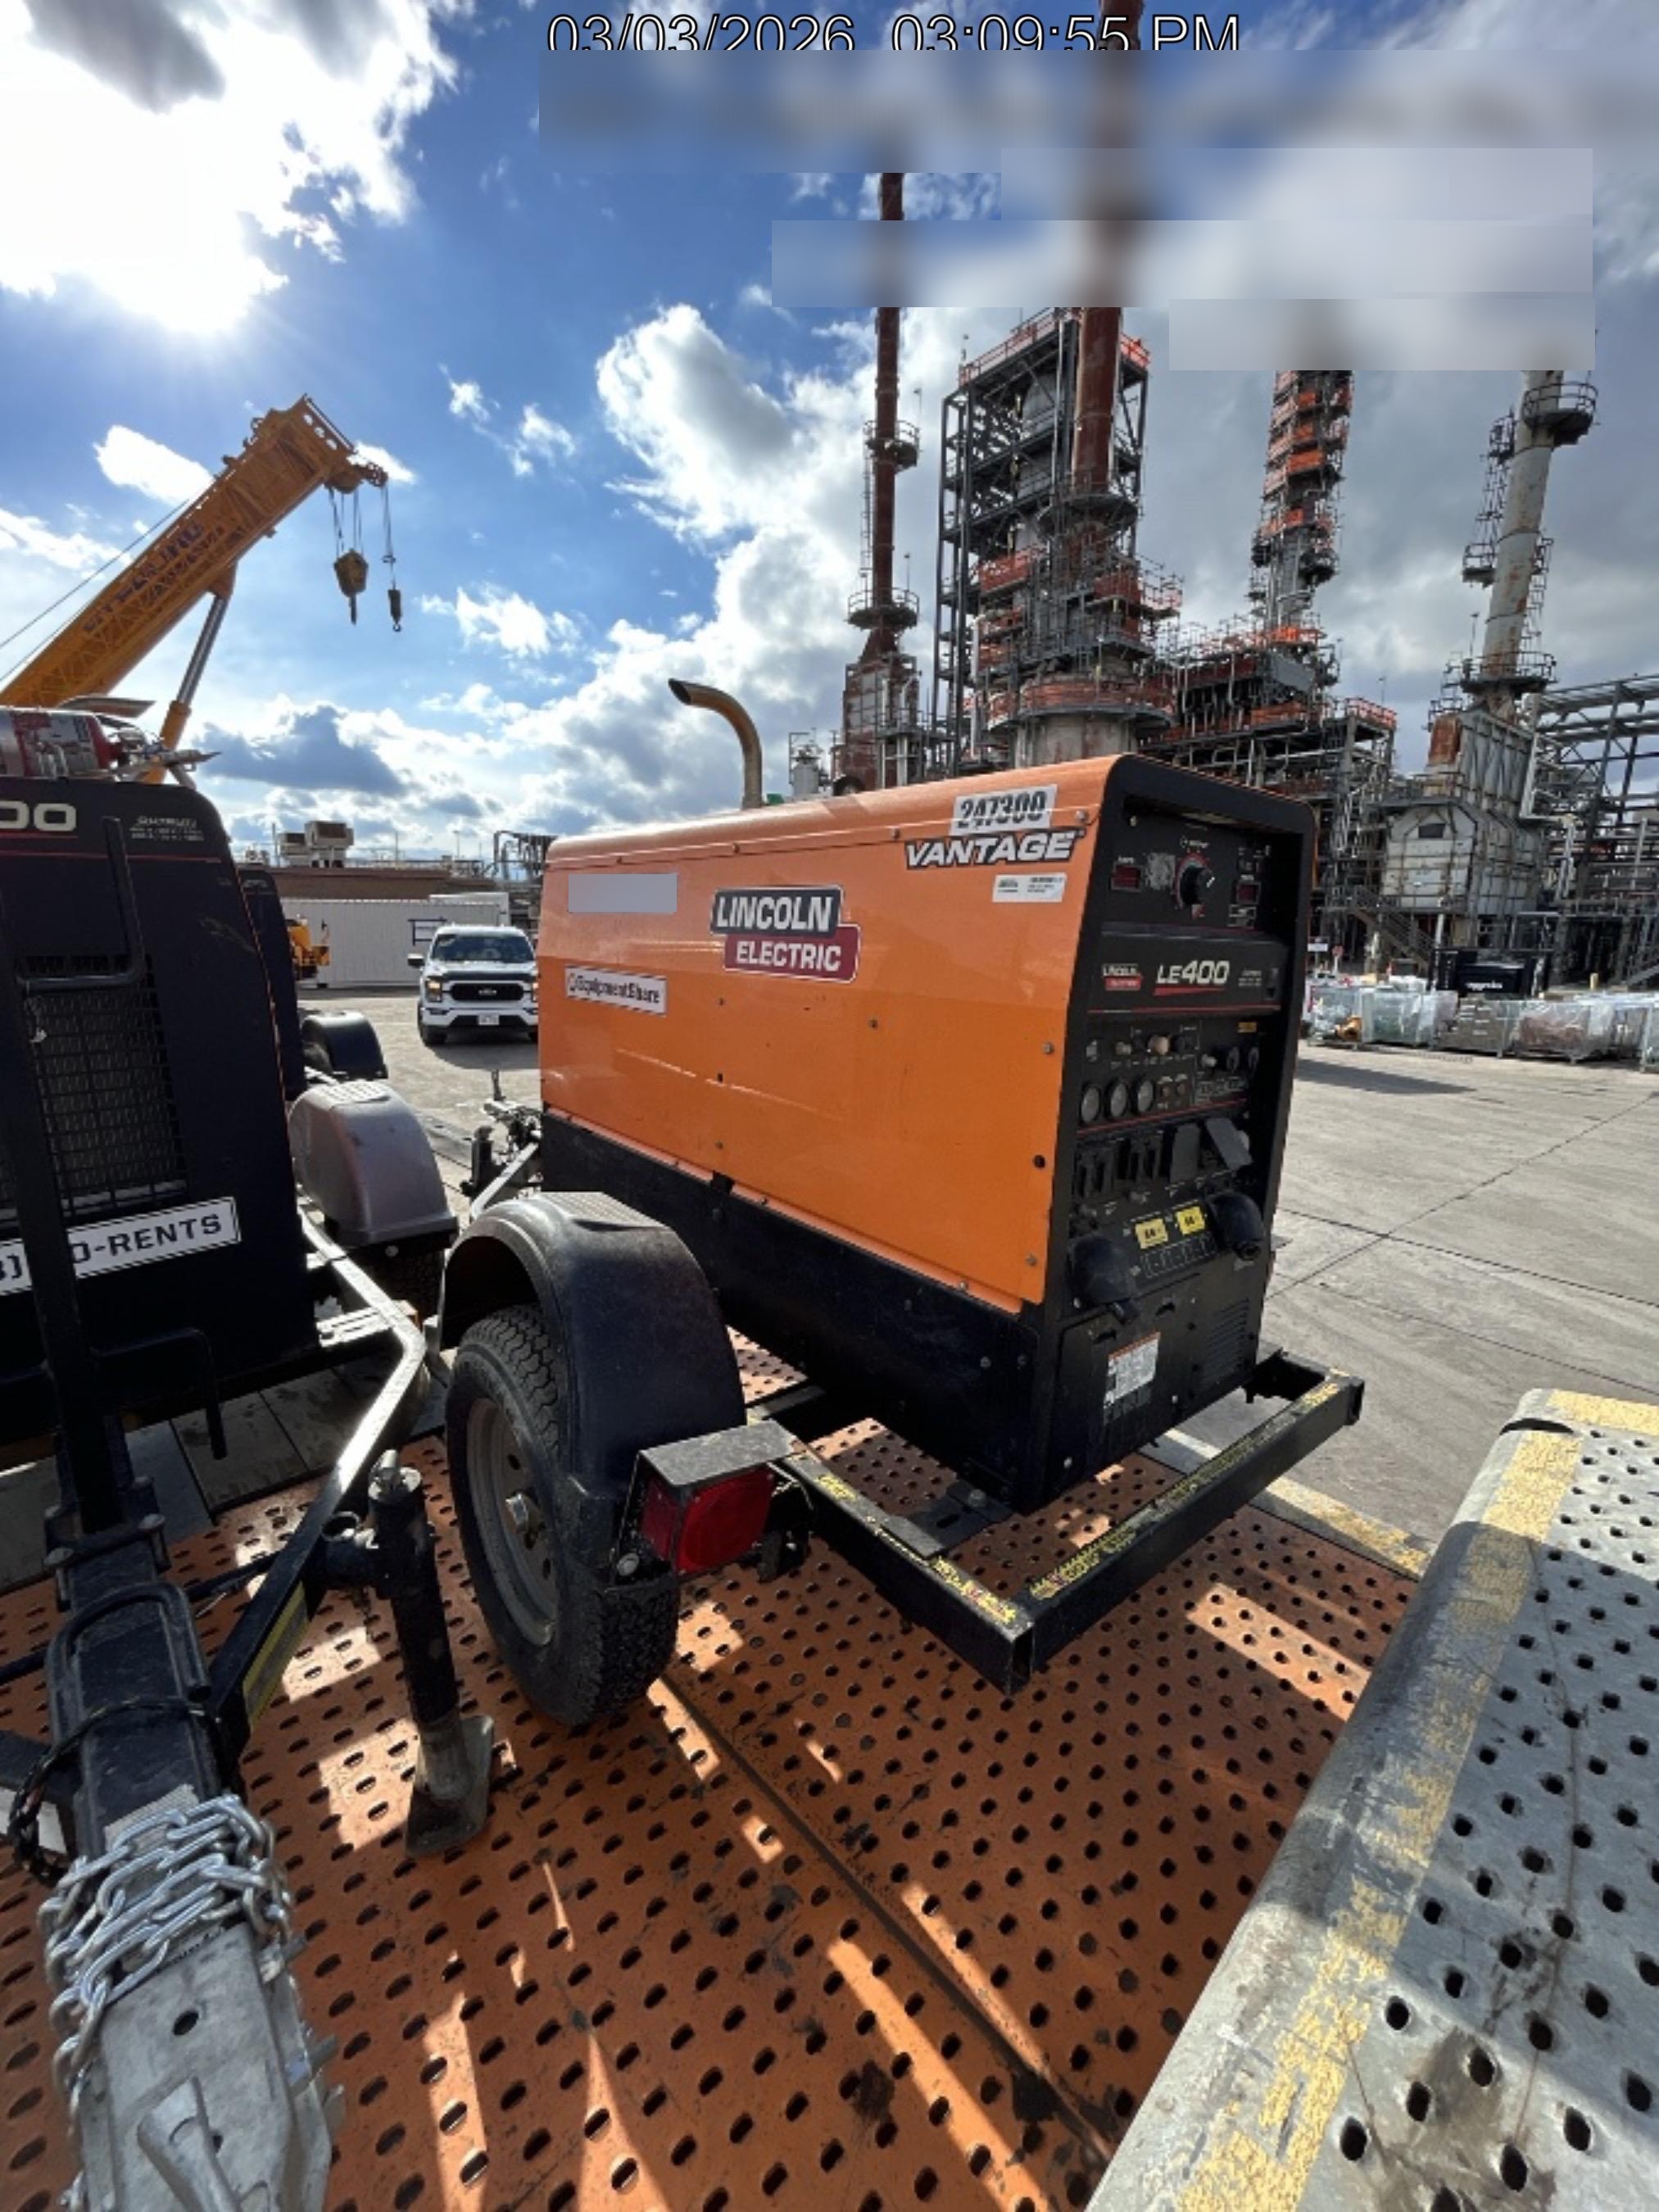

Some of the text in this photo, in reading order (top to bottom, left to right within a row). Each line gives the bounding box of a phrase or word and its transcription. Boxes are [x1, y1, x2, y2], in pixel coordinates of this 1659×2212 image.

[906, 830, 1077, 867] VANTAGE
[715, 895, 833, 931] LINCOLN
[736, 940, 842, 972] ELECTRIC
[1156, 959, 1230, 985] LE400
